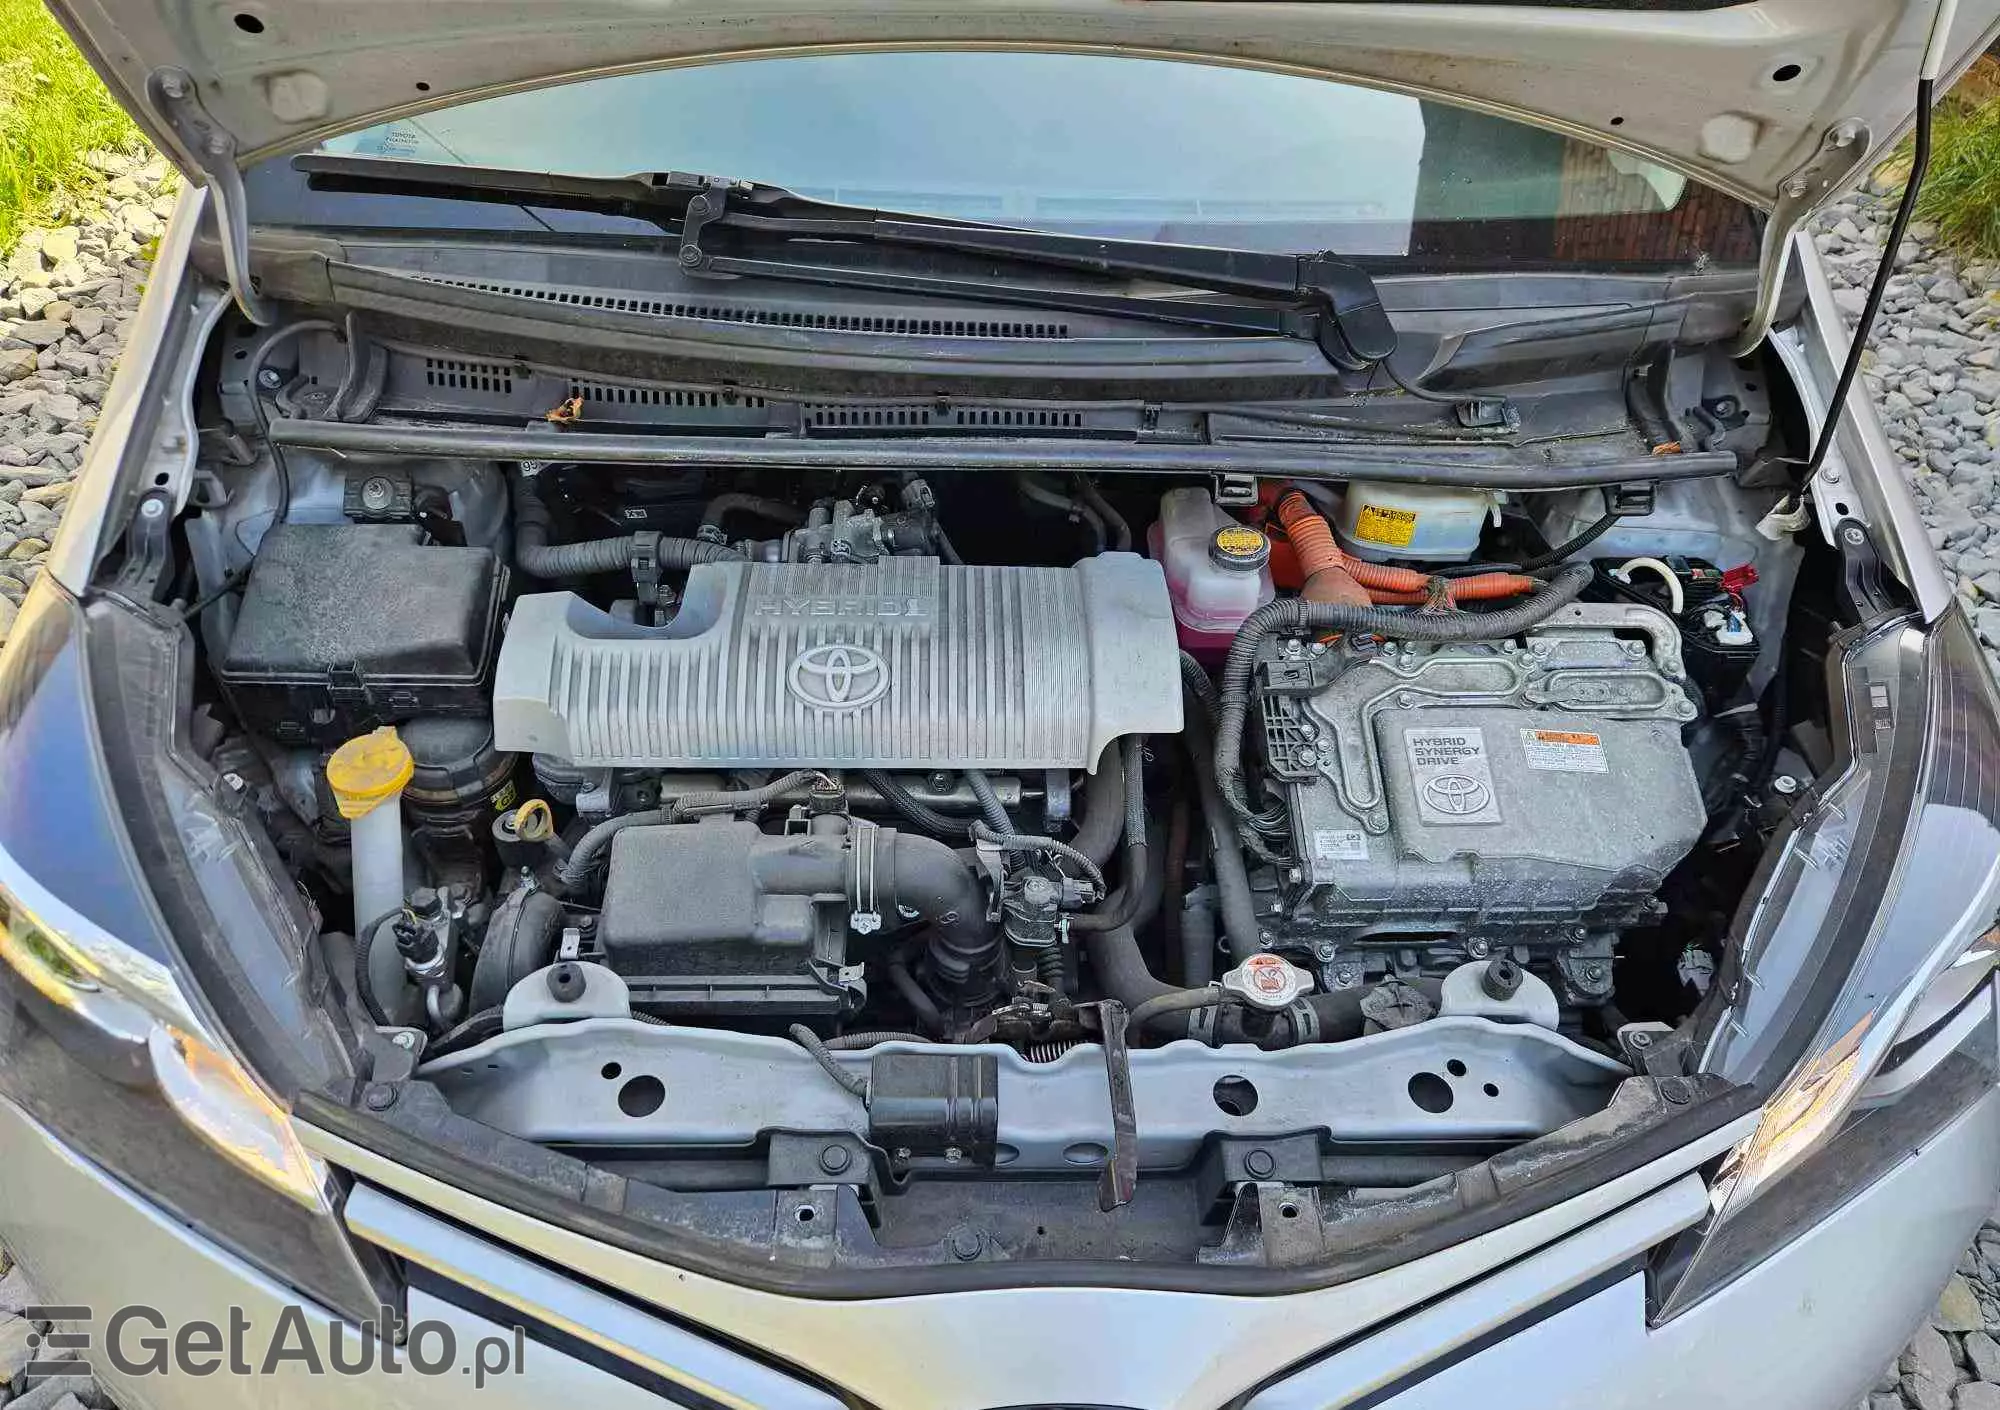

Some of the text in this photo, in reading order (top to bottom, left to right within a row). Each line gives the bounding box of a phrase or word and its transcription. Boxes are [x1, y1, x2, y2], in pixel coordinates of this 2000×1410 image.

[1413, 737, 1466, 747] HYBRID
[1415, 747, 1480, 757] SYNERGY
[1417, 757, 1461, 766] DRIVE
